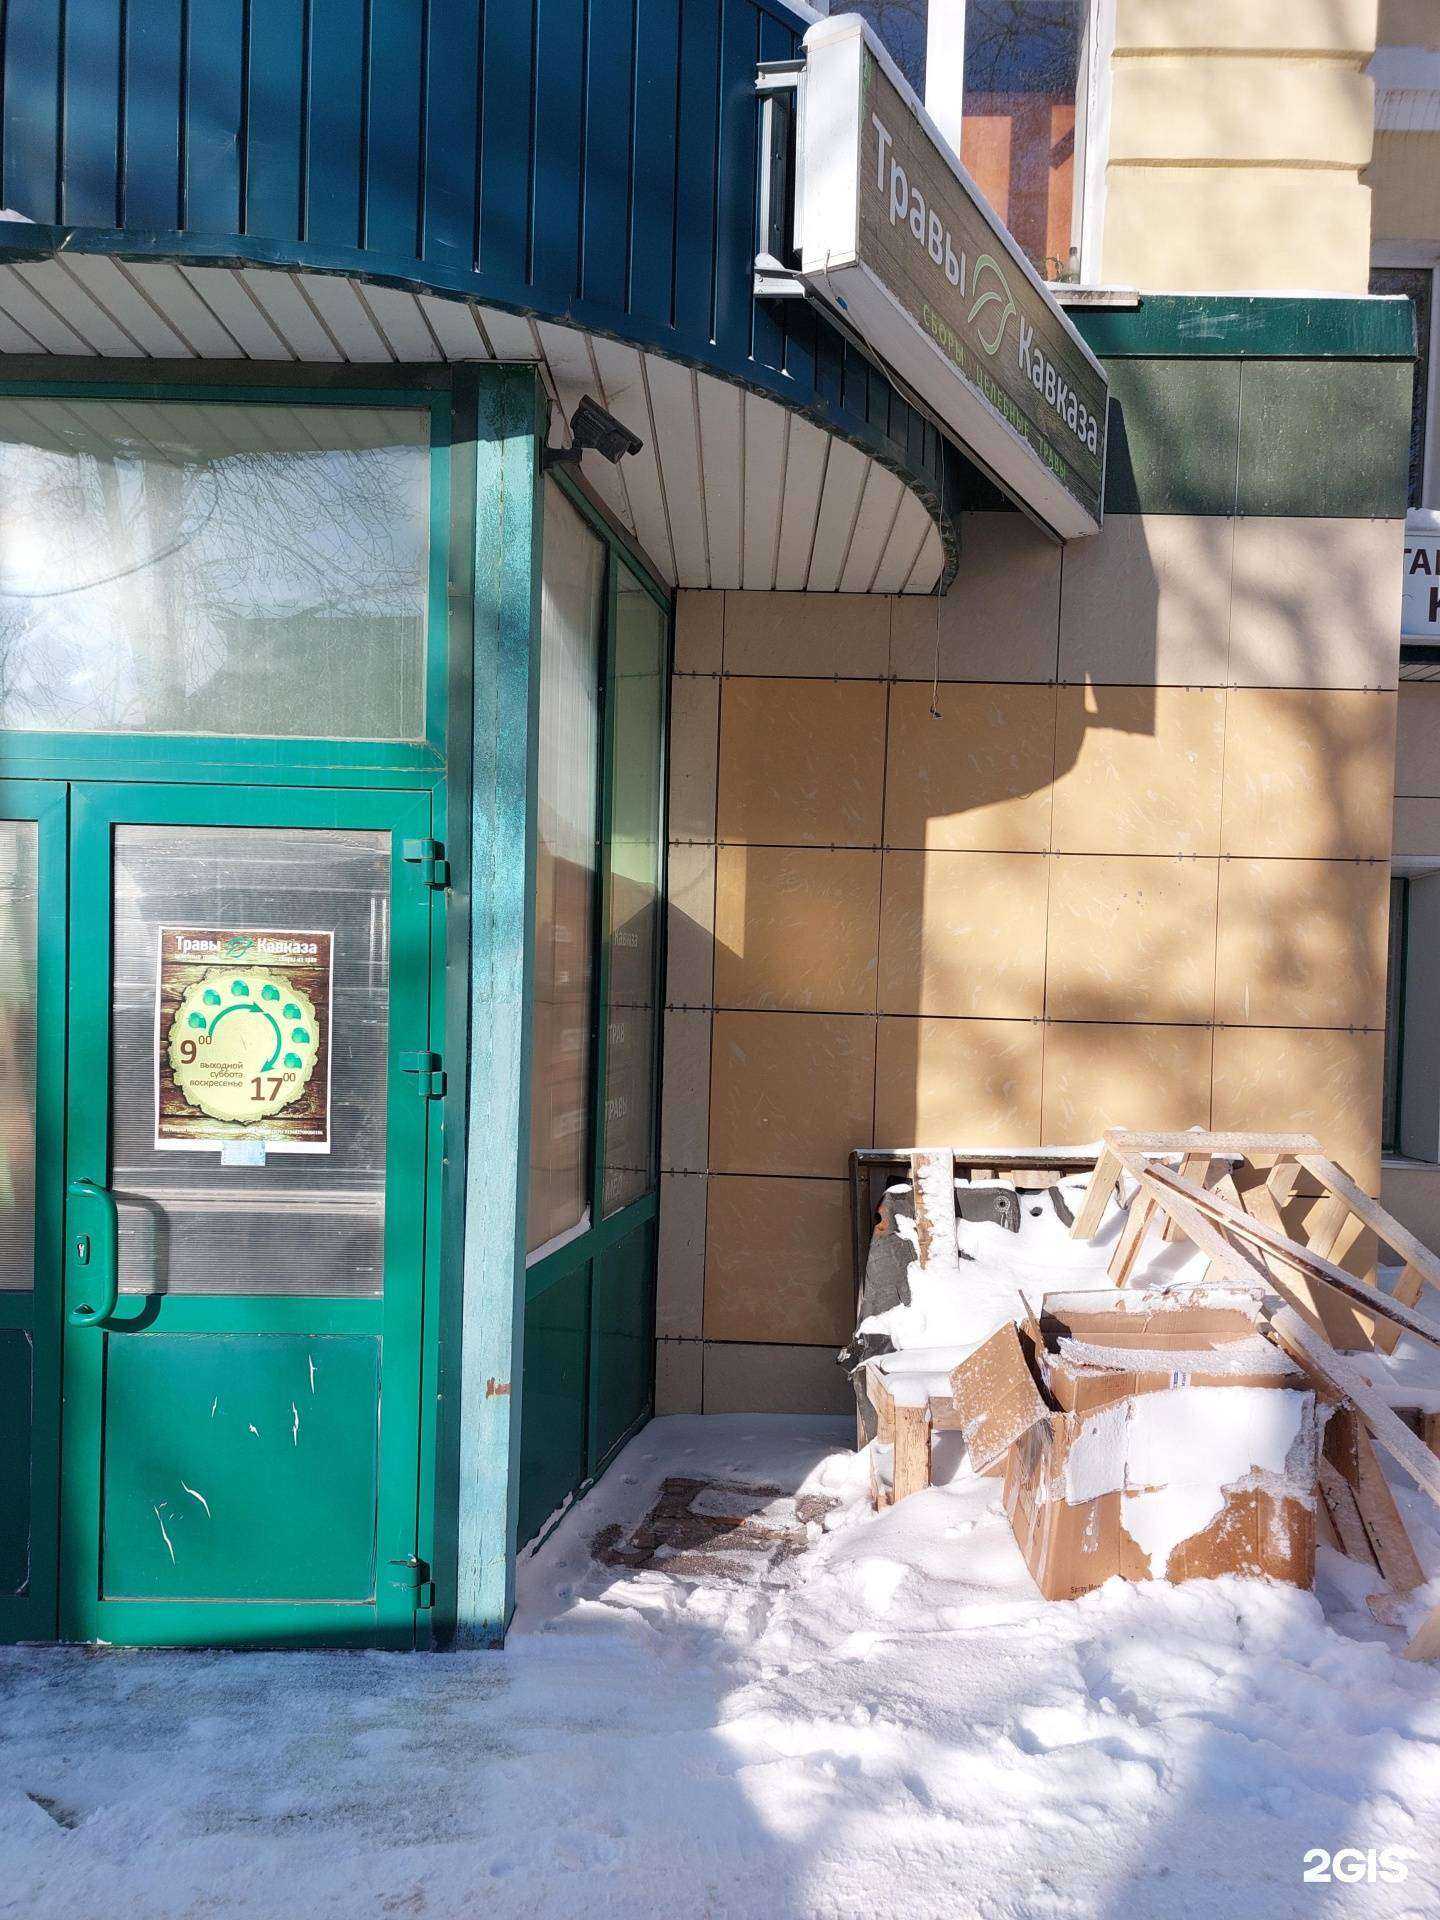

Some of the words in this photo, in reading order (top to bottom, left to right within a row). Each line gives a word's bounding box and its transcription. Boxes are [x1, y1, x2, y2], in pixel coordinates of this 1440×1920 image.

[871, 111, 967, 299] Травы
[1017, 314, 1098, 456] Кавказа
[922, 303, 966, 367] СБОРЫ
[175, 935, 221, 953] Травы
[257, 937, 318, 954] Кавказа
[199, 1061, 243, 1072] выходной
[210, 1067, 243, 1079] суббота
[189, 1079, 243, 1089] воскресенье
[250, 1076, 283, 1102] 17
